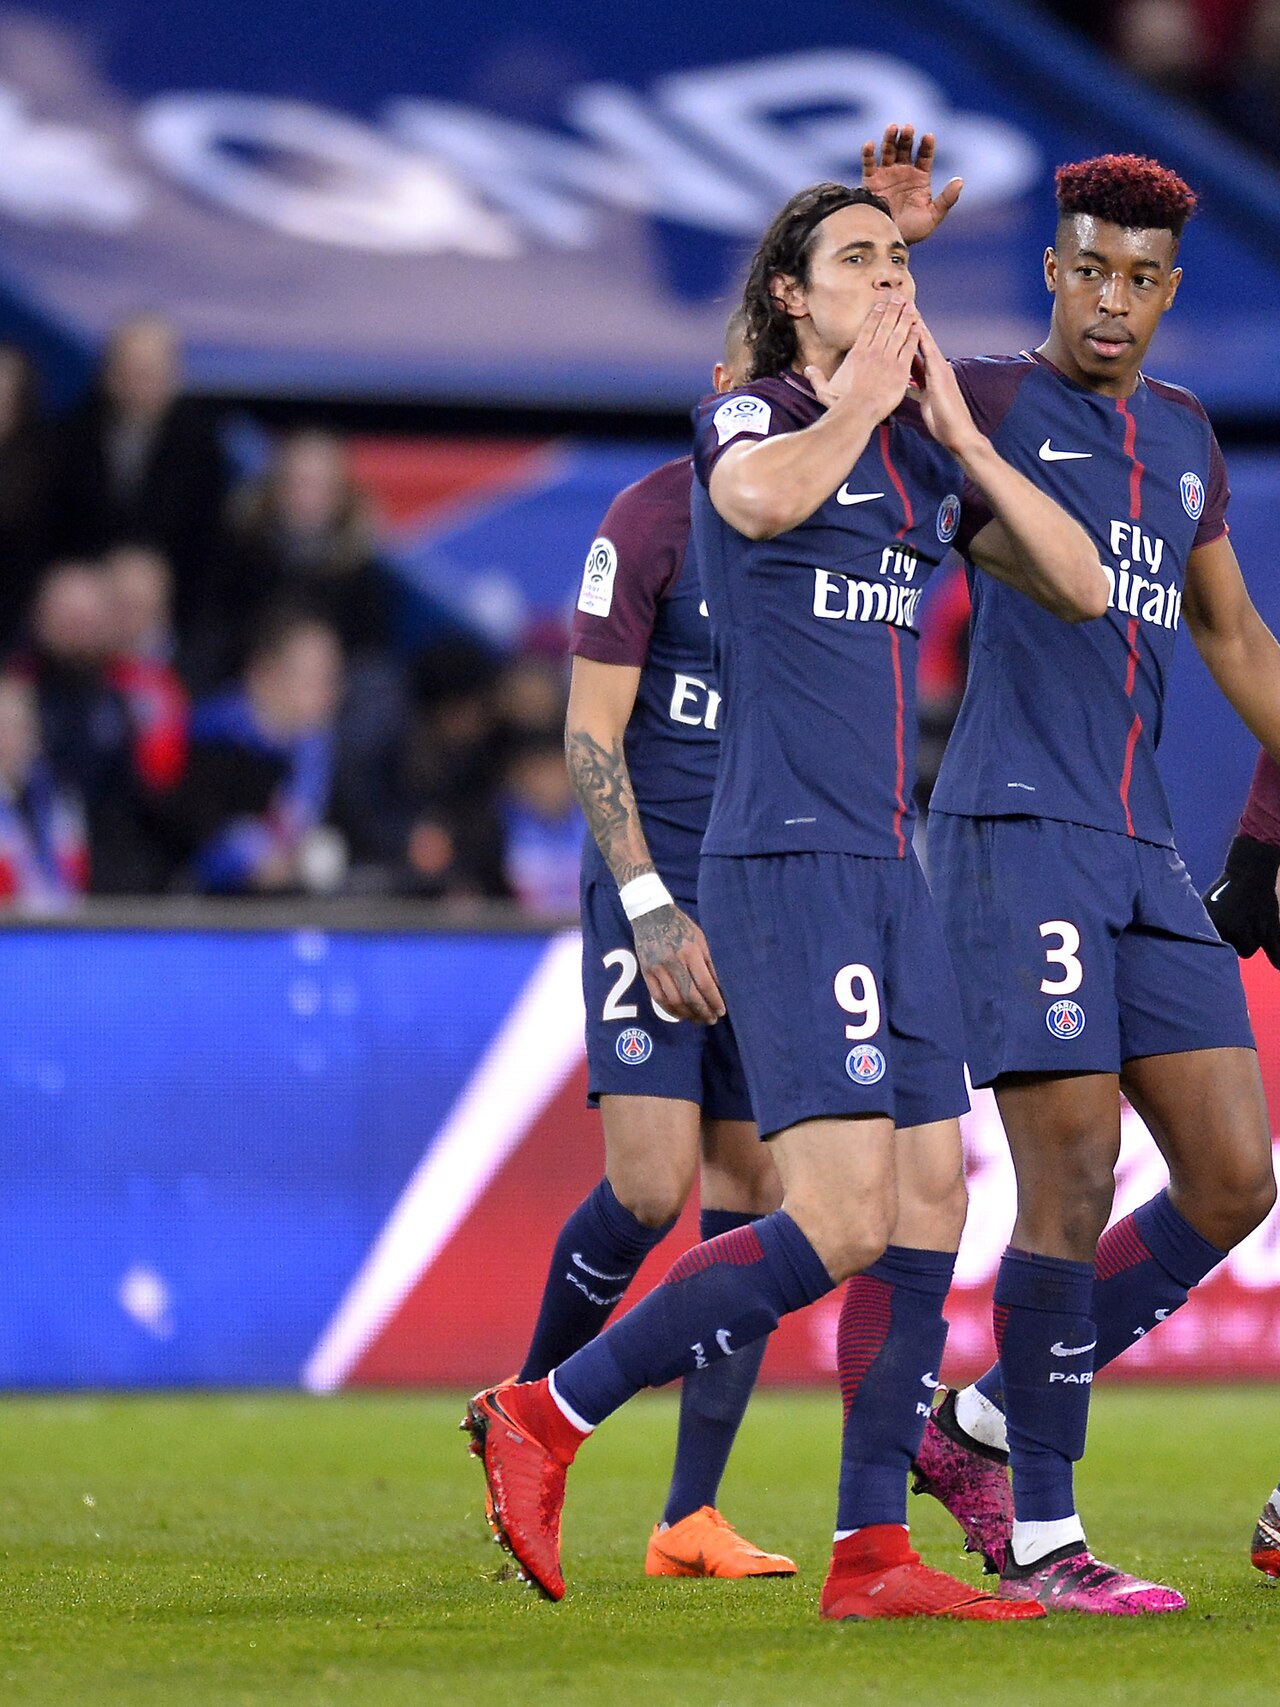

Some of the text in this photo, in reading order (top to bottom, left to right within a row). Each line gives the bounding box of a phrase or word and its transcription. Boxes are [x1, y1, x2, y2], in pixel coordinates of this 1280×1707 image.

[1109, 520, 1164, 574] Fly
[1102, 559, 1182, 631] irat
[603, 949, 680, 1023] 2
[1039, 920, 1083, 995] 3
[621, 1030, 646, 1040] PARIS
[834, 963, 880, 1040] 9
[1053, 1002, 1077, 1013] PARIS
